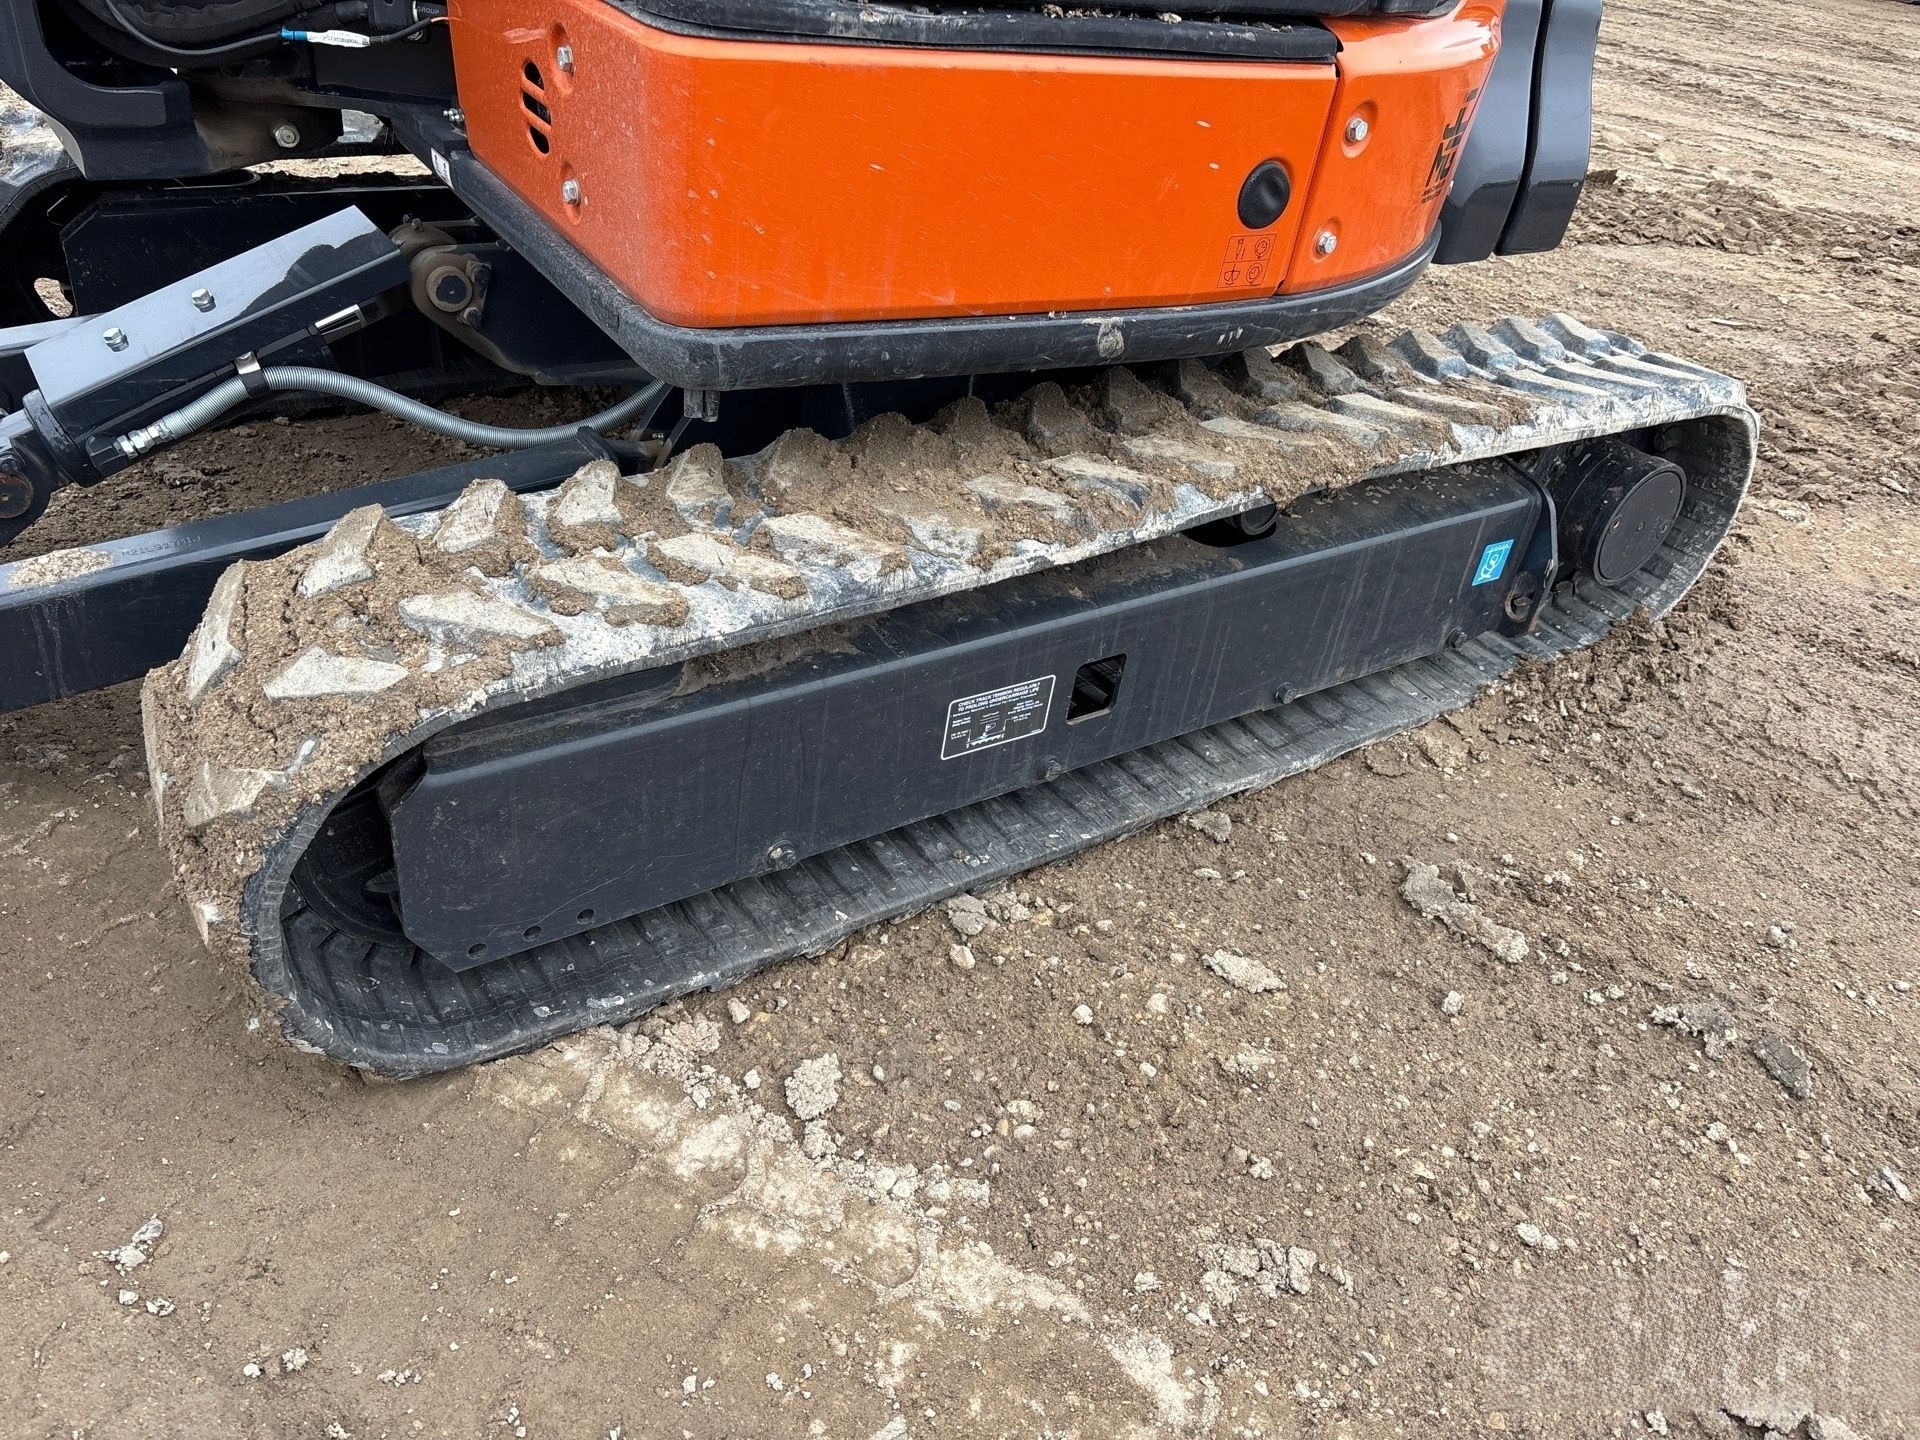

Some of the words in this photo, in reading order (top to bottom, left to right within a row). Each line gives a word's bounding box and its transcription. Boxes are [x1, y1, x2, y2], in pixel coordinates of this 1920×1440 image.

[958, 699, 976, 708] CHECK
[976, 695, 992, 703] TRACK
[993, 690, 1013, 699] TENSION
[1013, 682, 1041, 692] REGULARLY
[965, 701, 989, 710] PROLONG
[989, 690, 1029, 704] UNDERCARRIAGE
